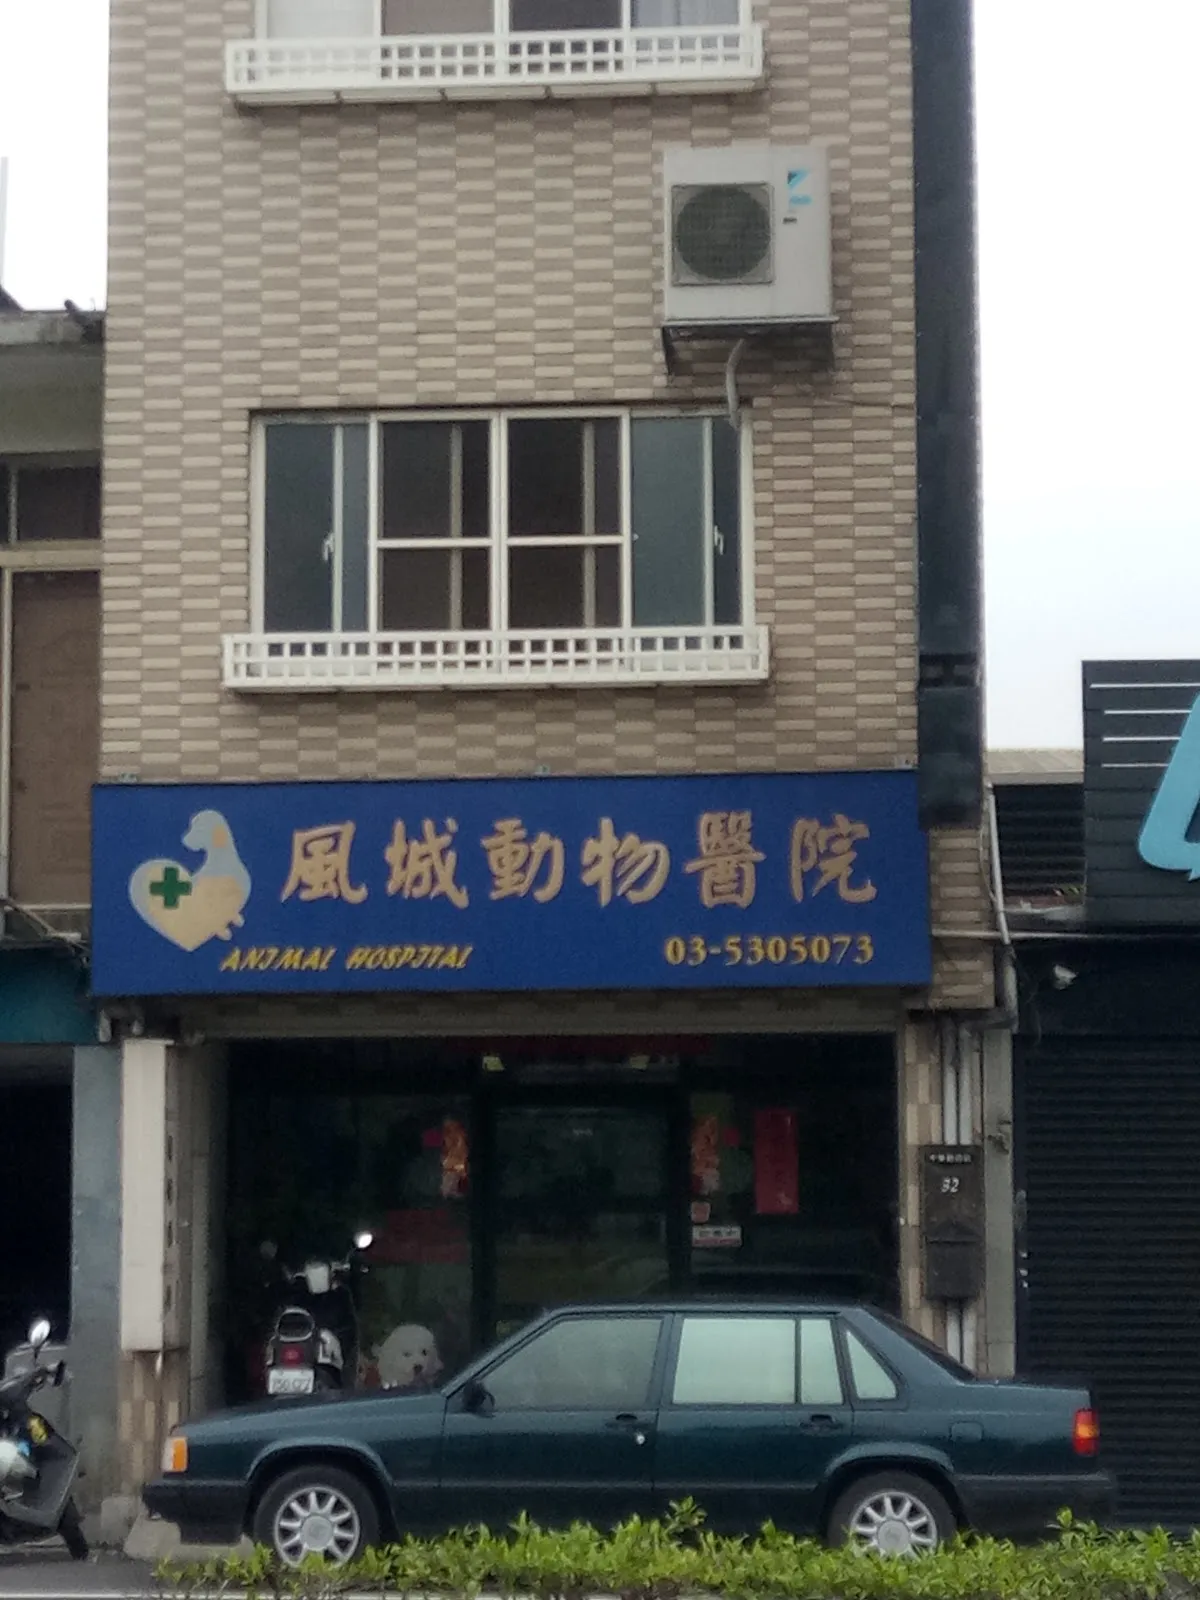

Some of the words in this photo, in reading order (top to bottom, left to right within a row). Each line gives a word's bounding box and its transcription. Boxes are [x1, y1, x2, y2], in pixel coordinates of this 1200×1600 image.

[281, 810, 877, 909] 風城動物醫院
[219, 946, 337, 972] ANIMAL
[345, 944, 474, 971] HOSPITAL
[664, 933, 875, 966] 03-5305073
